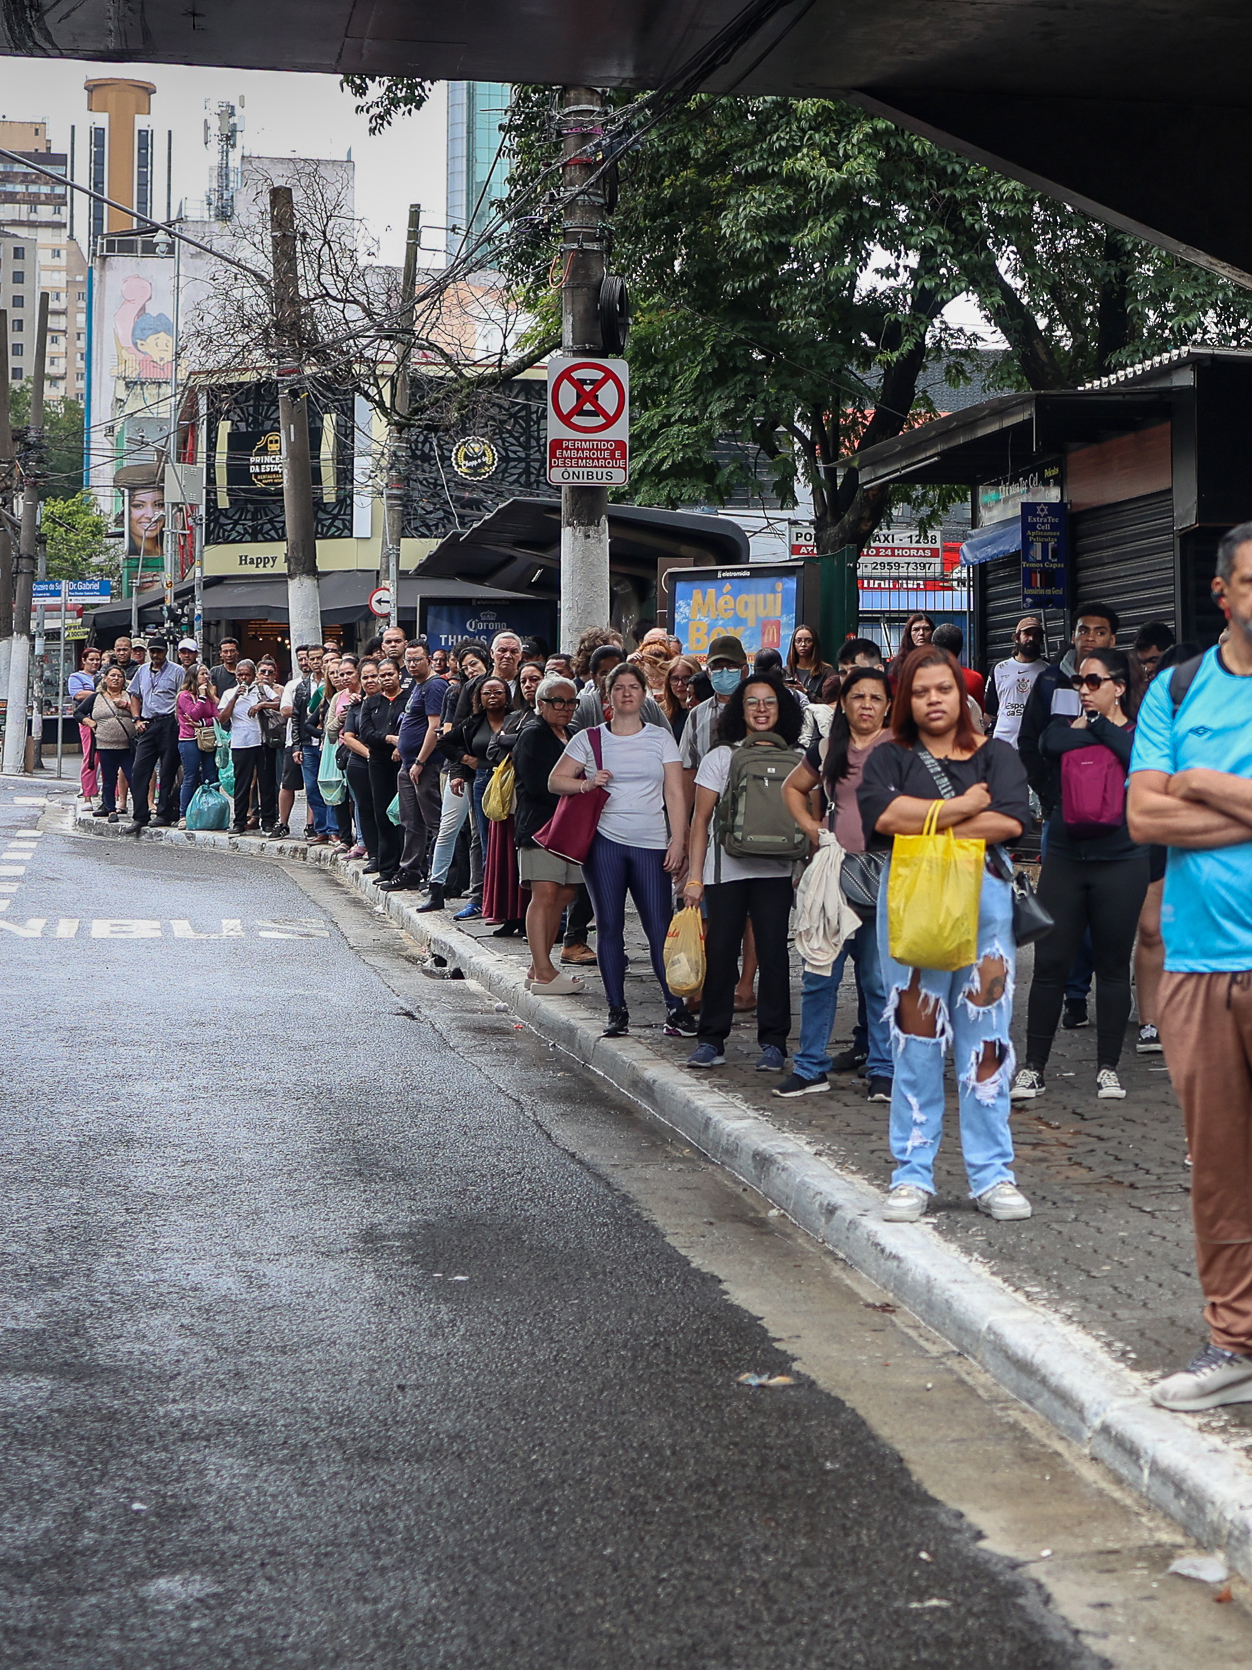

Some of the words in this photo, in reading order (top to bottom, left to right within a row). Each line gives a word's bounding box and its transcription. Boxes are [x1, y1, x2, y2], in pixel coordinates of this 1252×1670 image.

[562, 441, 615, 449] PERMITIDO
[556, 450, 611, 458] EMBARQUE
[551, 459, 626, 467] DESEMBARQUE
[250, 465, 260, 473] DA
[561, 468, 614, 481] ÔNIBUS
[871, 534, 894, 544] AXI
[894, 549, 932, 557] HORAS
[238, 554, 278, 568] Happy
[1044, 561, 1064, 569] Capas
[871, 561, 933, 571] 2959-7397
[77, 581, 100, 590] Gabriel
[689, 582, 783, 628] Méqui
[466, 618, 507, 633] Corona
